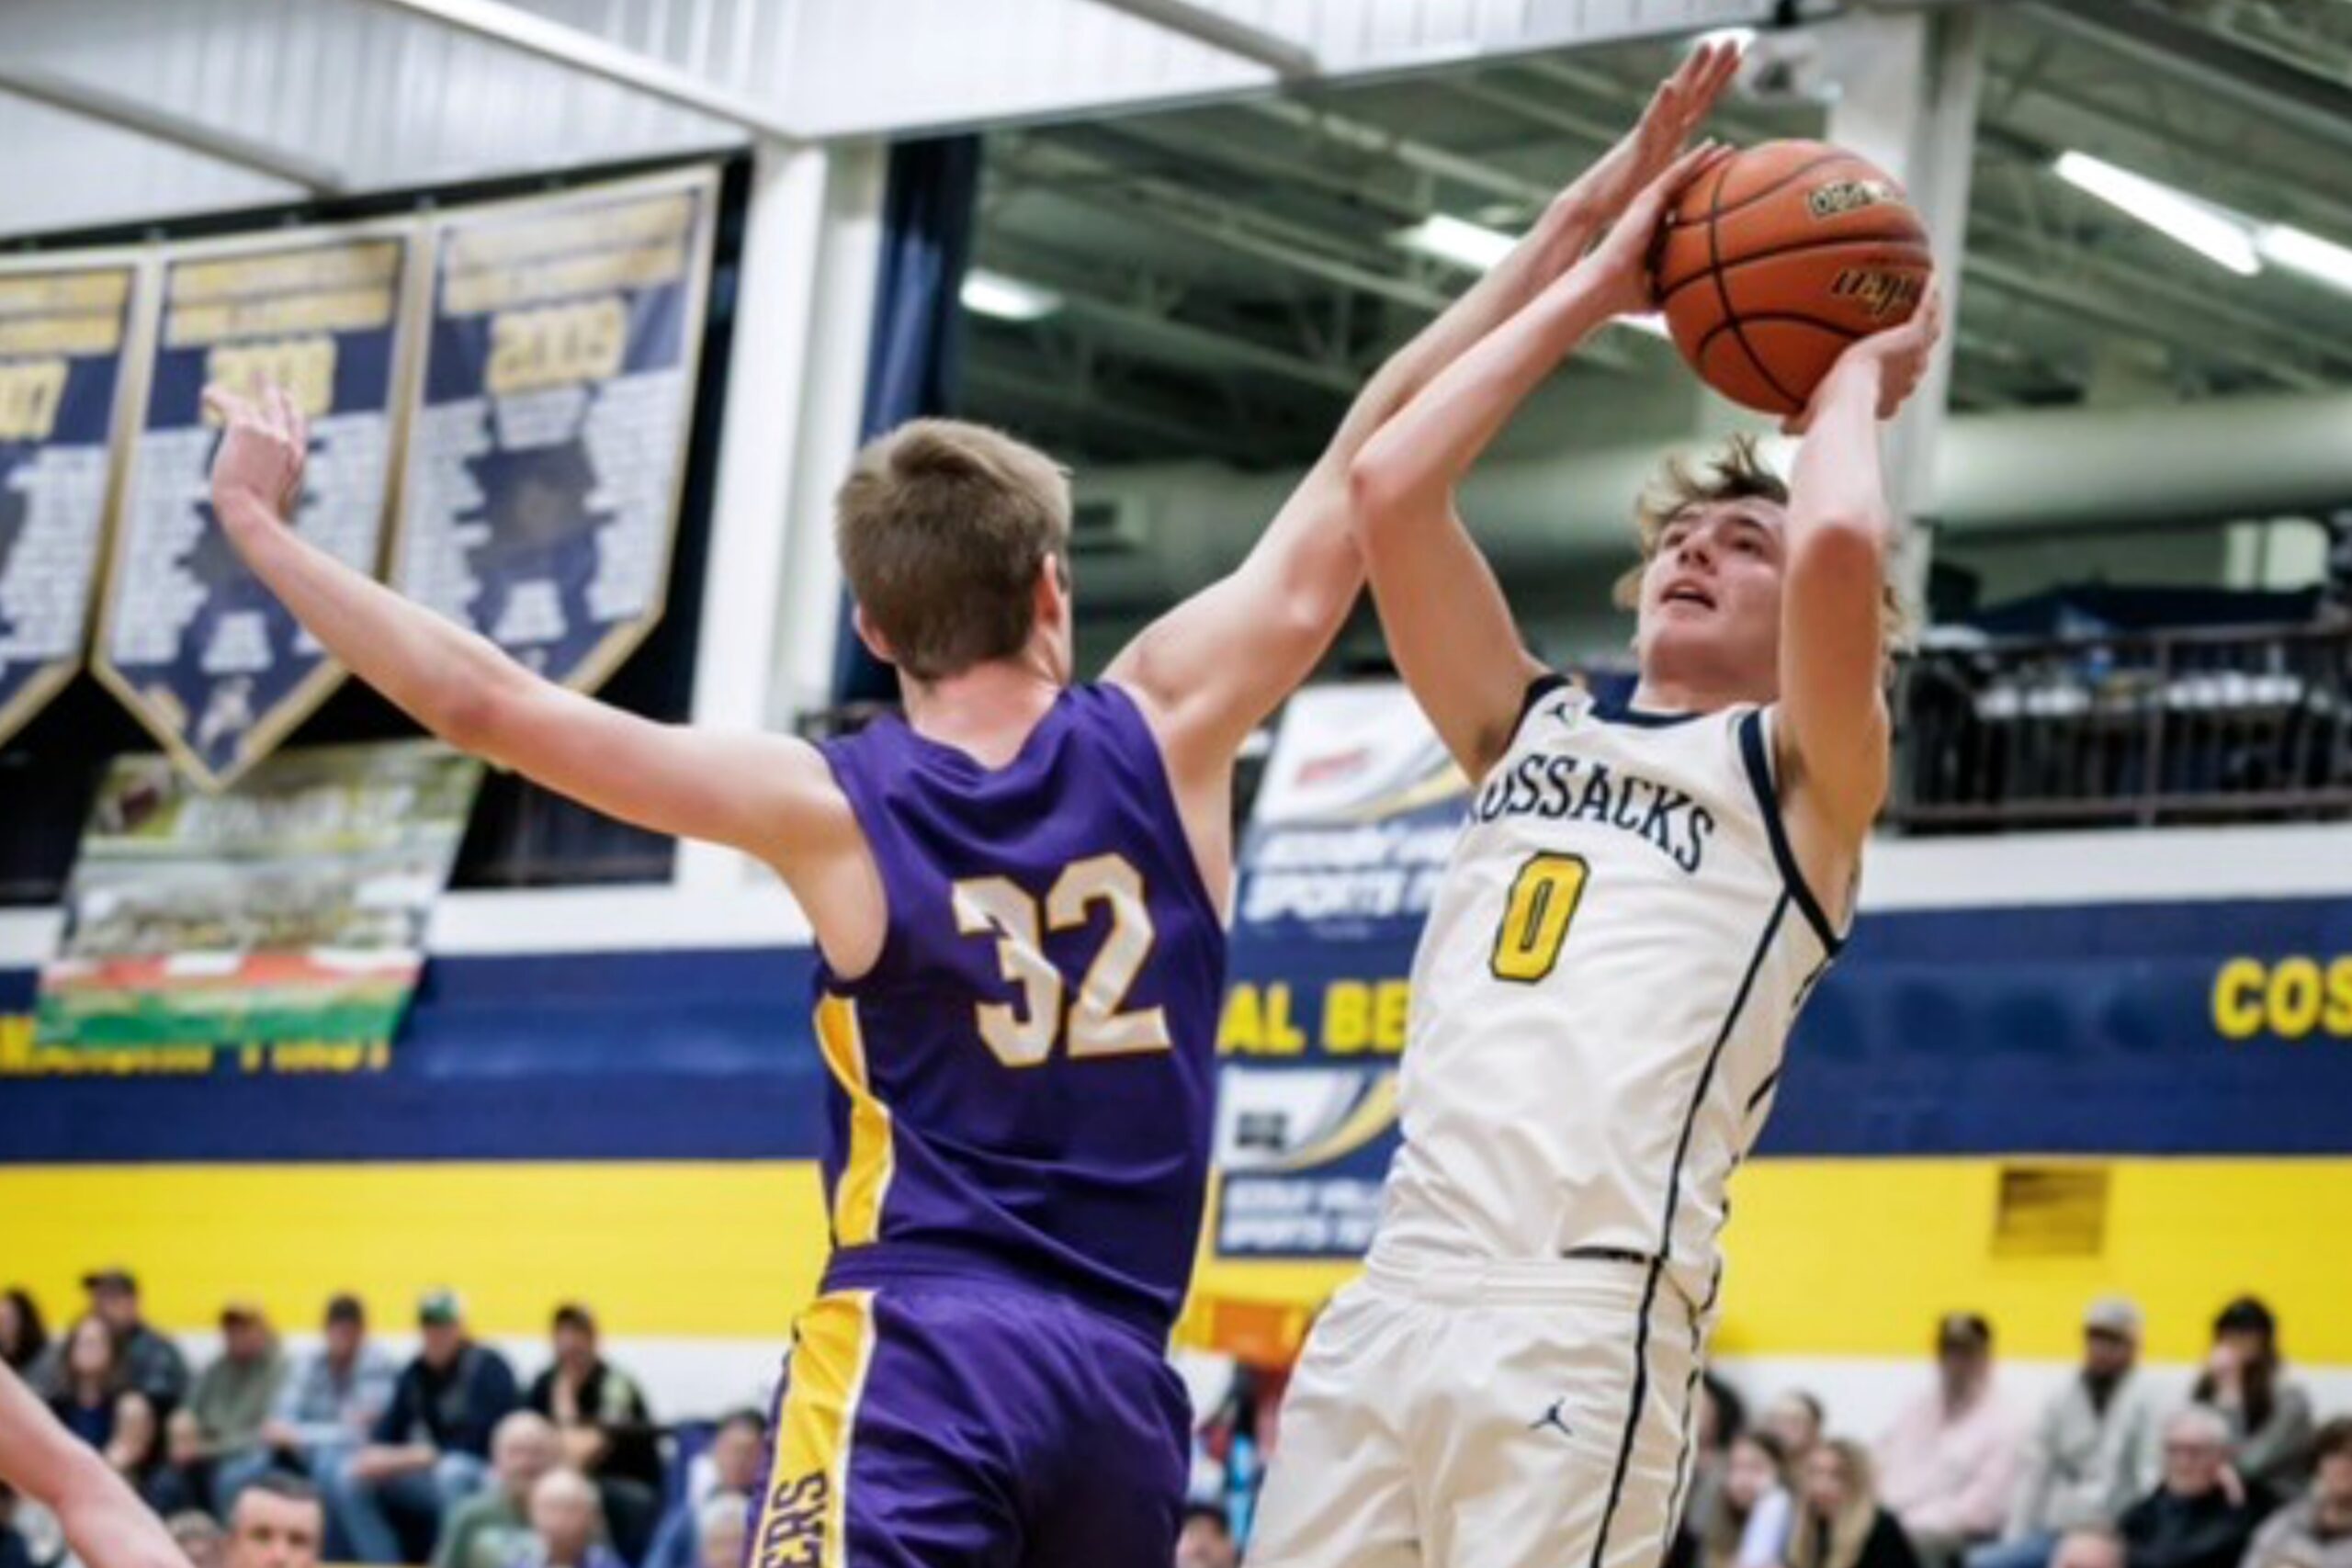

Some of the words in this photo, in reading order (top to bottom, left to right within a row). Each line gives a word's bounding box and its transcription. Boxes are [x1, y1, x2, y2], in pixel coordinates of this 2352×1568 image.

[1473, 753, 1715, 874] OSSACKS
[951, 852, 1171, 1067] 32
[1490, 850, 1590, 985] 0
